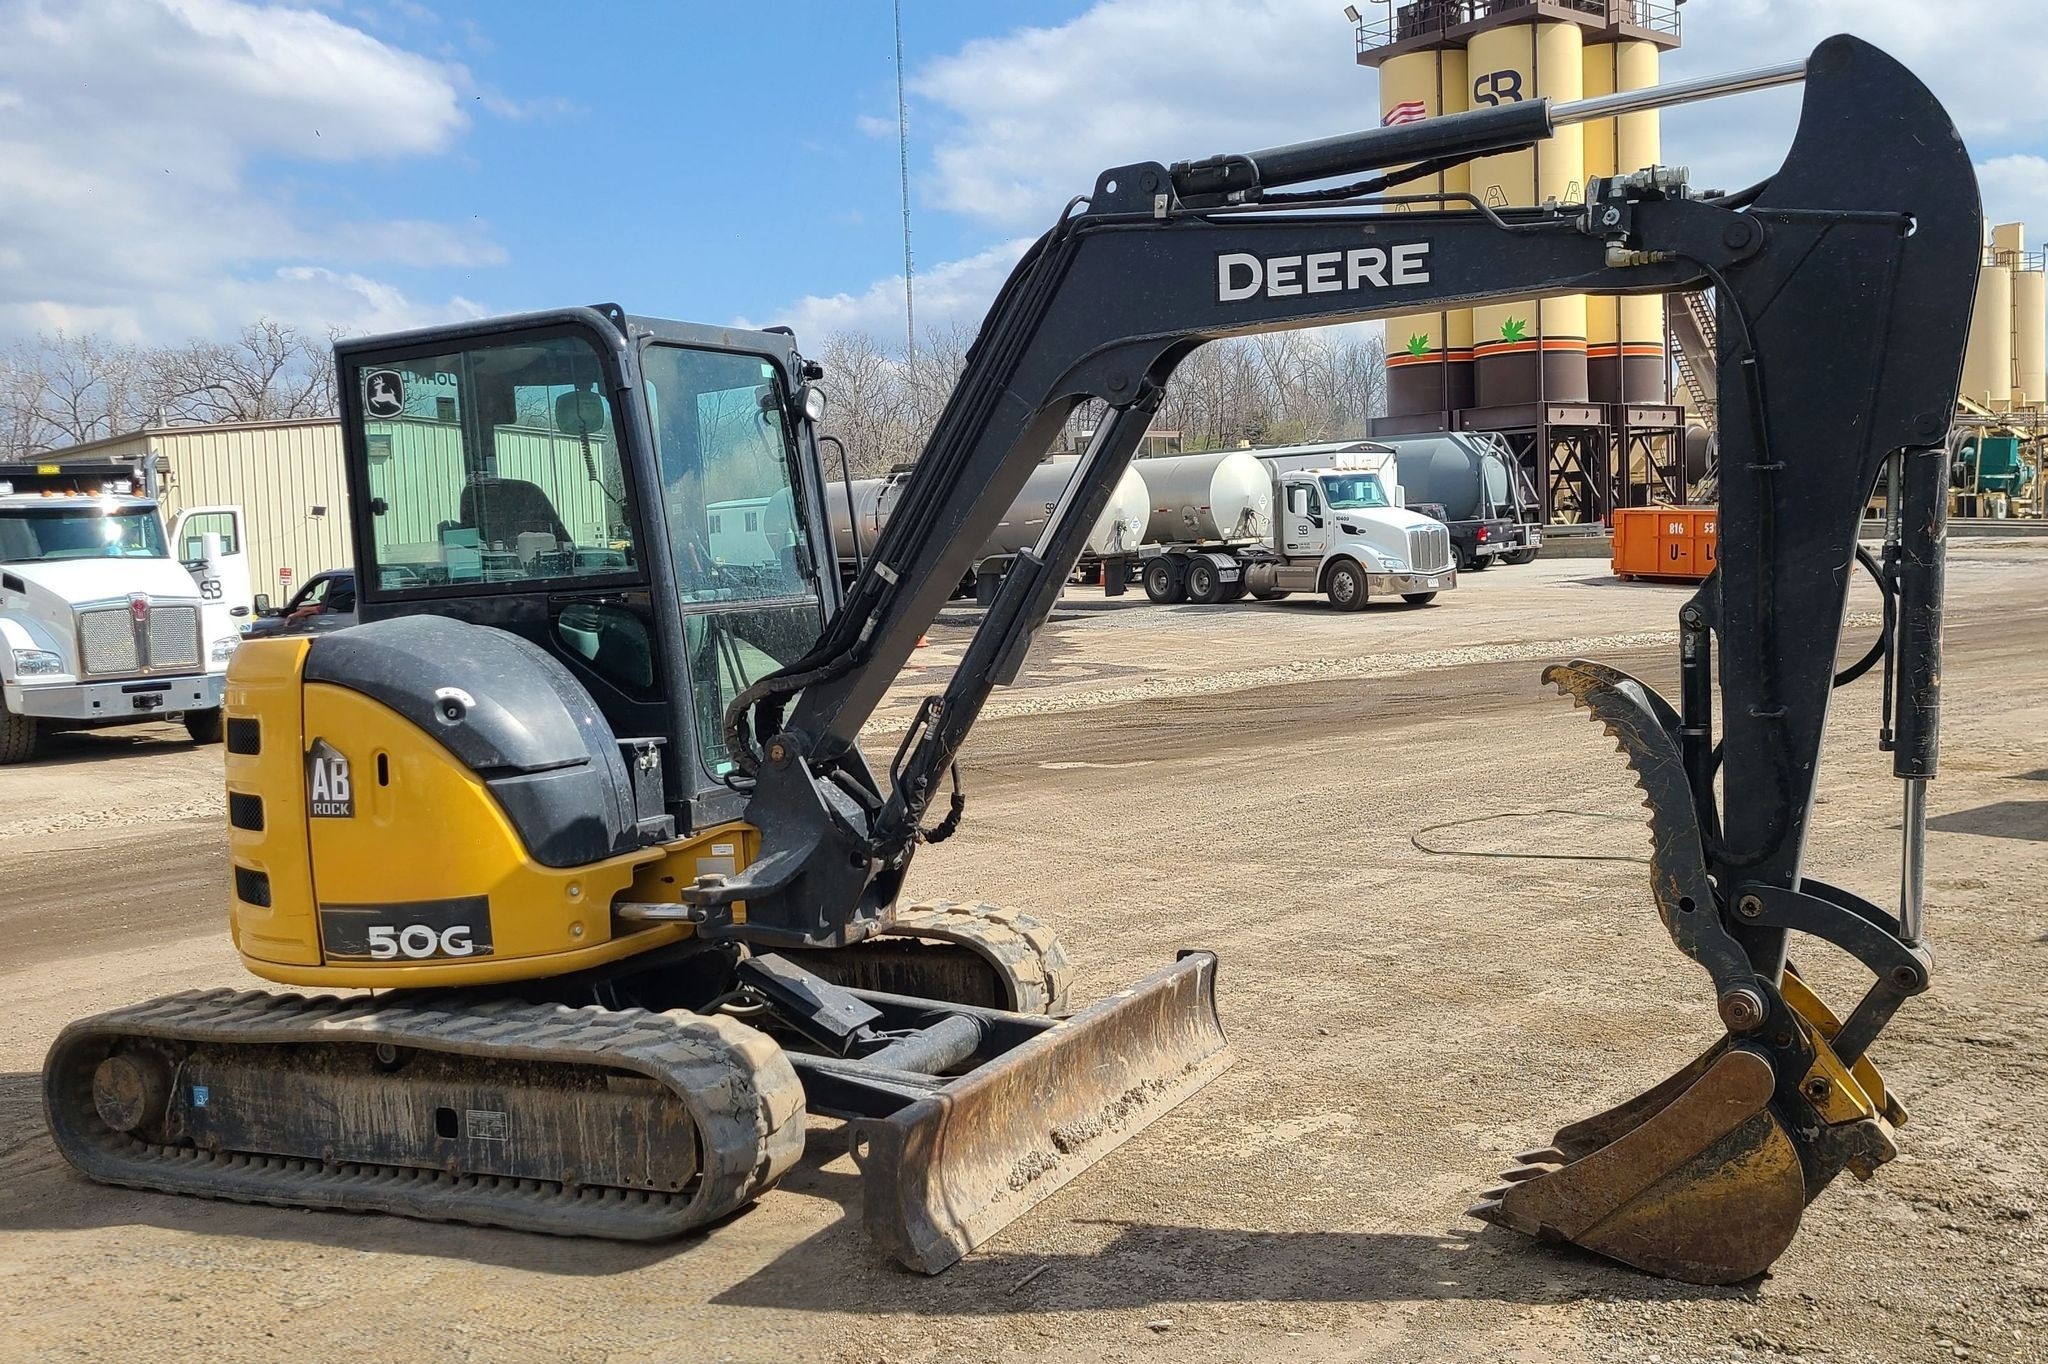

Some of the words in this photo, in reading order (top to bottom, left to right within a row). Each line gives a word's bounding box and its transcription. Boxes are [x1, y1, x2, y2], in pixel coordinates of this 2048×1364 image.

[1218, 242, 1430, 302] DEERE
[1669, 522, 1684, 535] 816
[1704, 522, 1717, 534] 53
[1670, 543, 1687, 561] U-
[311, 757, 351, 801] AB
[313, 802, 350, 816] ROCK
[367, 924, 474, 959] 50G
